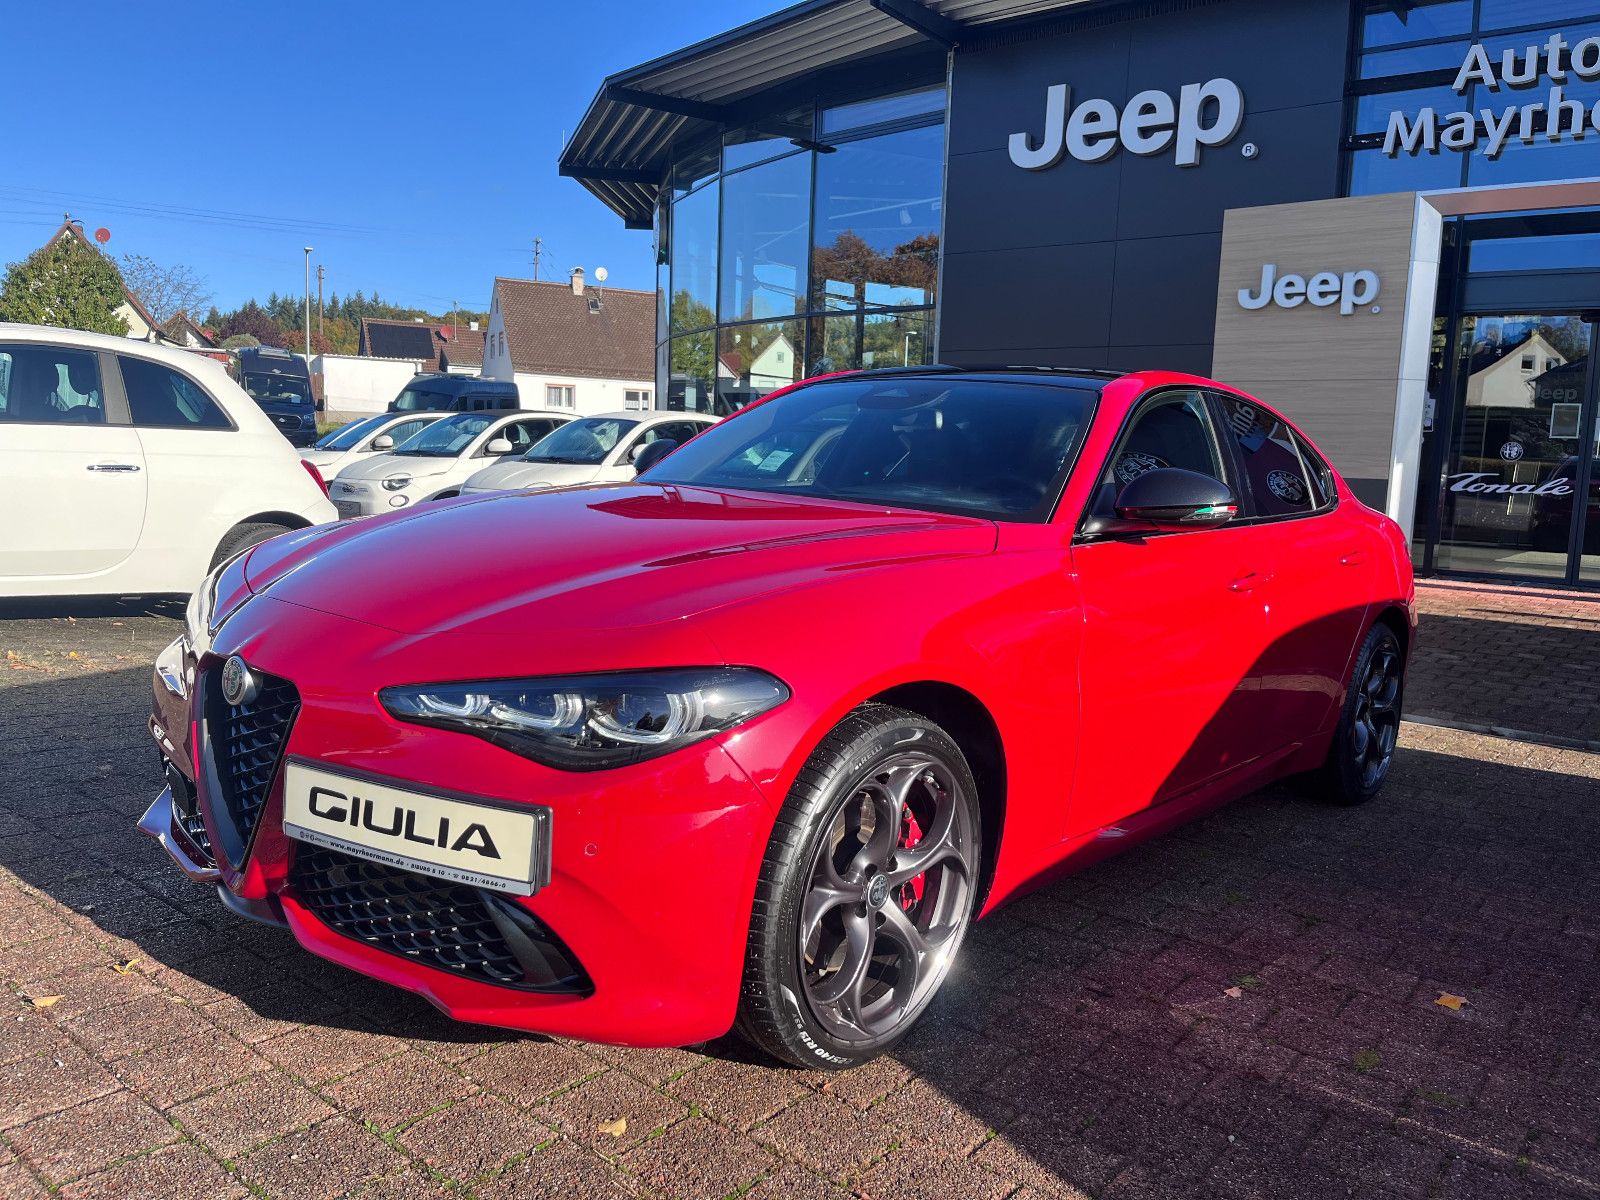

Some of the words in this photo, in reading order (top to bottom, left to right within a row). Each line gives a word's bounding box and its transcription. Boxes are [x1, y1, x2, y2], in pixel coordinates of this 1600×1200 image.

[1452, 33, 1600, 91] Auto
[1008, 78, 1244, 170] Jeep
[1382, 87, 1600, 156] Mayrh
[1238, 264, 1380, 315] Jeep
[1448, 473, 1574, 496] Tonale
[308, 786, 502, 860] GIULIA
